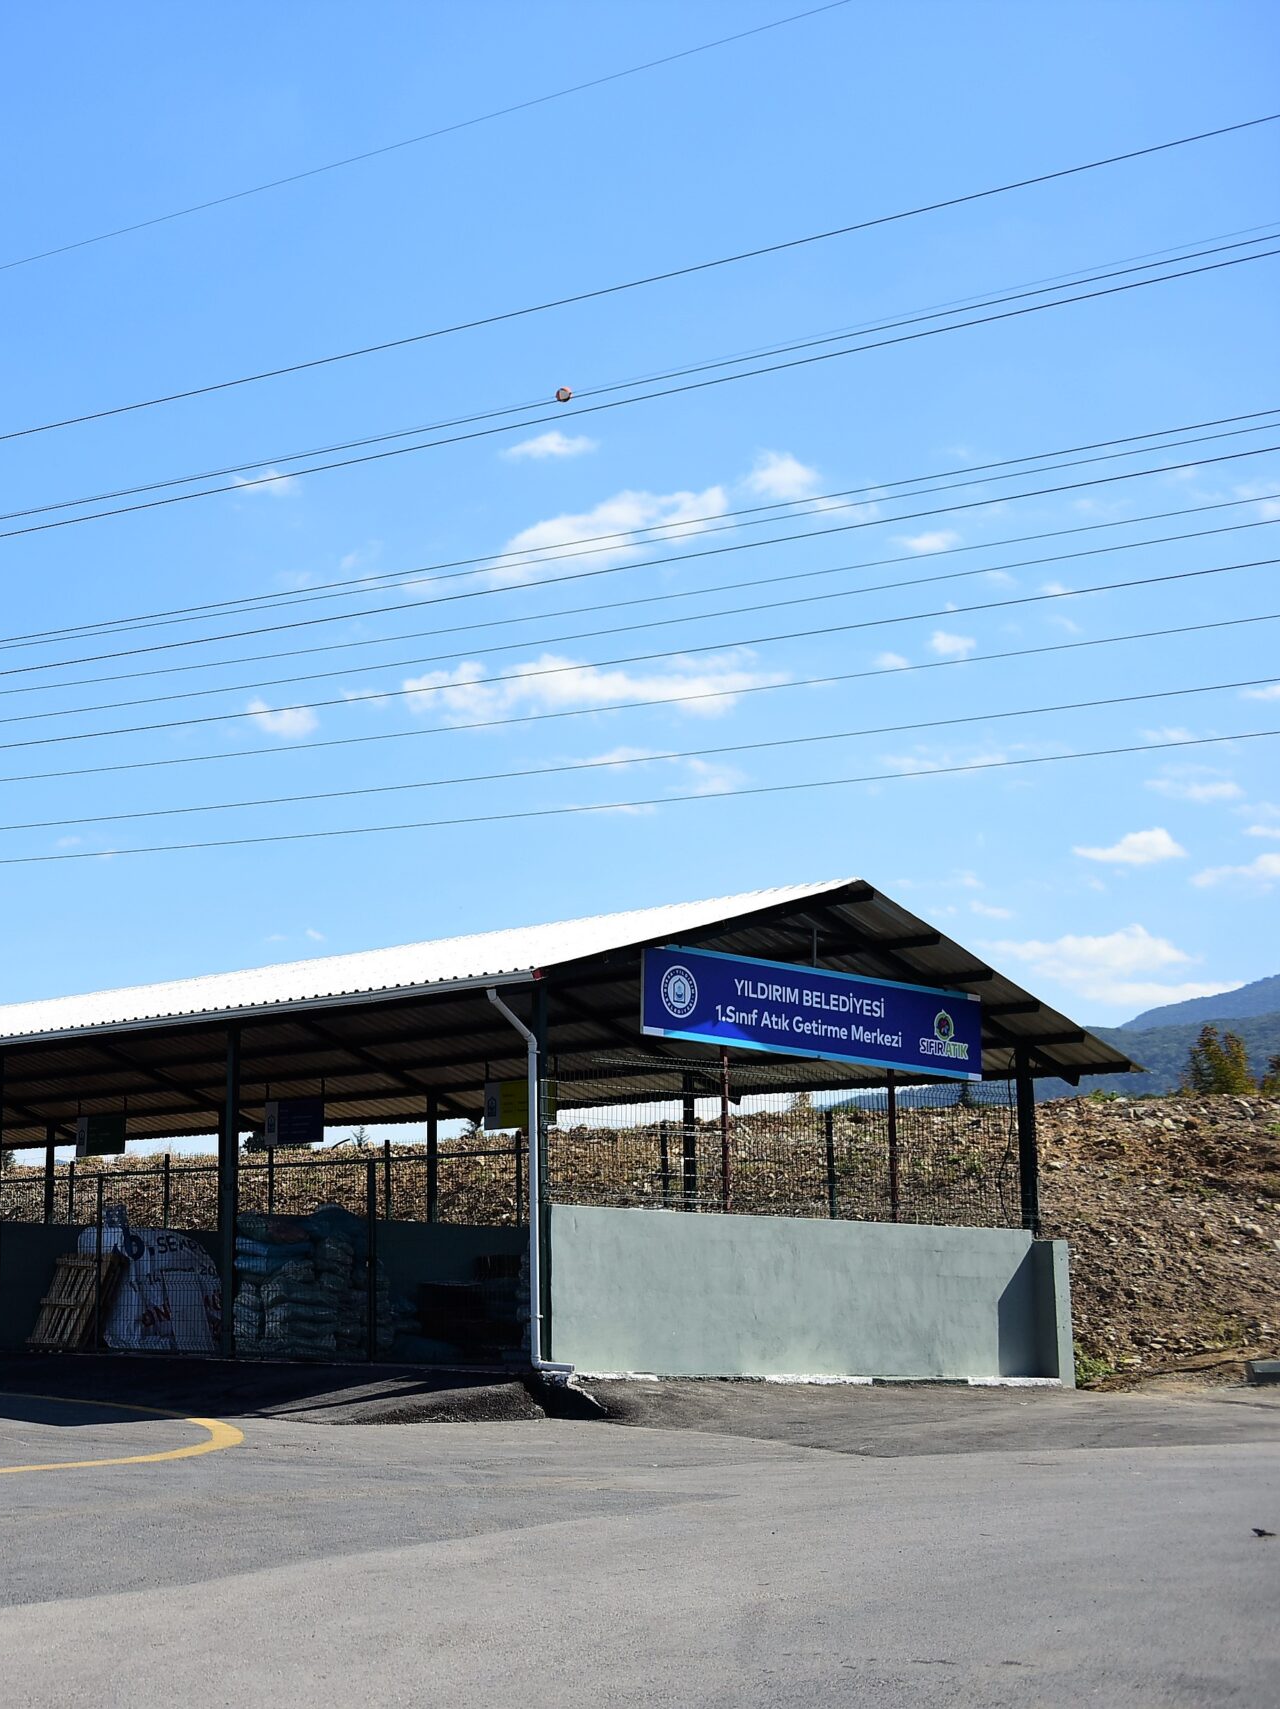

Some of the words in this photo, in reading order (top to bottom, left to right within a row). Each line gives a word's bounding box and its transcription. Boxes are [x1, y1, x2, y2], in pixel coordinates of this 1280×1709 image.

[734, 978, 799, 1004] YILDIRIM
[803, 989, 885, 1018] BELEDİYESİ
[715, 1004, 758, 1027] 1.Sınıf
[761, 1011, 789, 1031] Atık
[792, 1016, 848, 1040] Getirme
[851, 1024, 902, 1048] Merkezi
